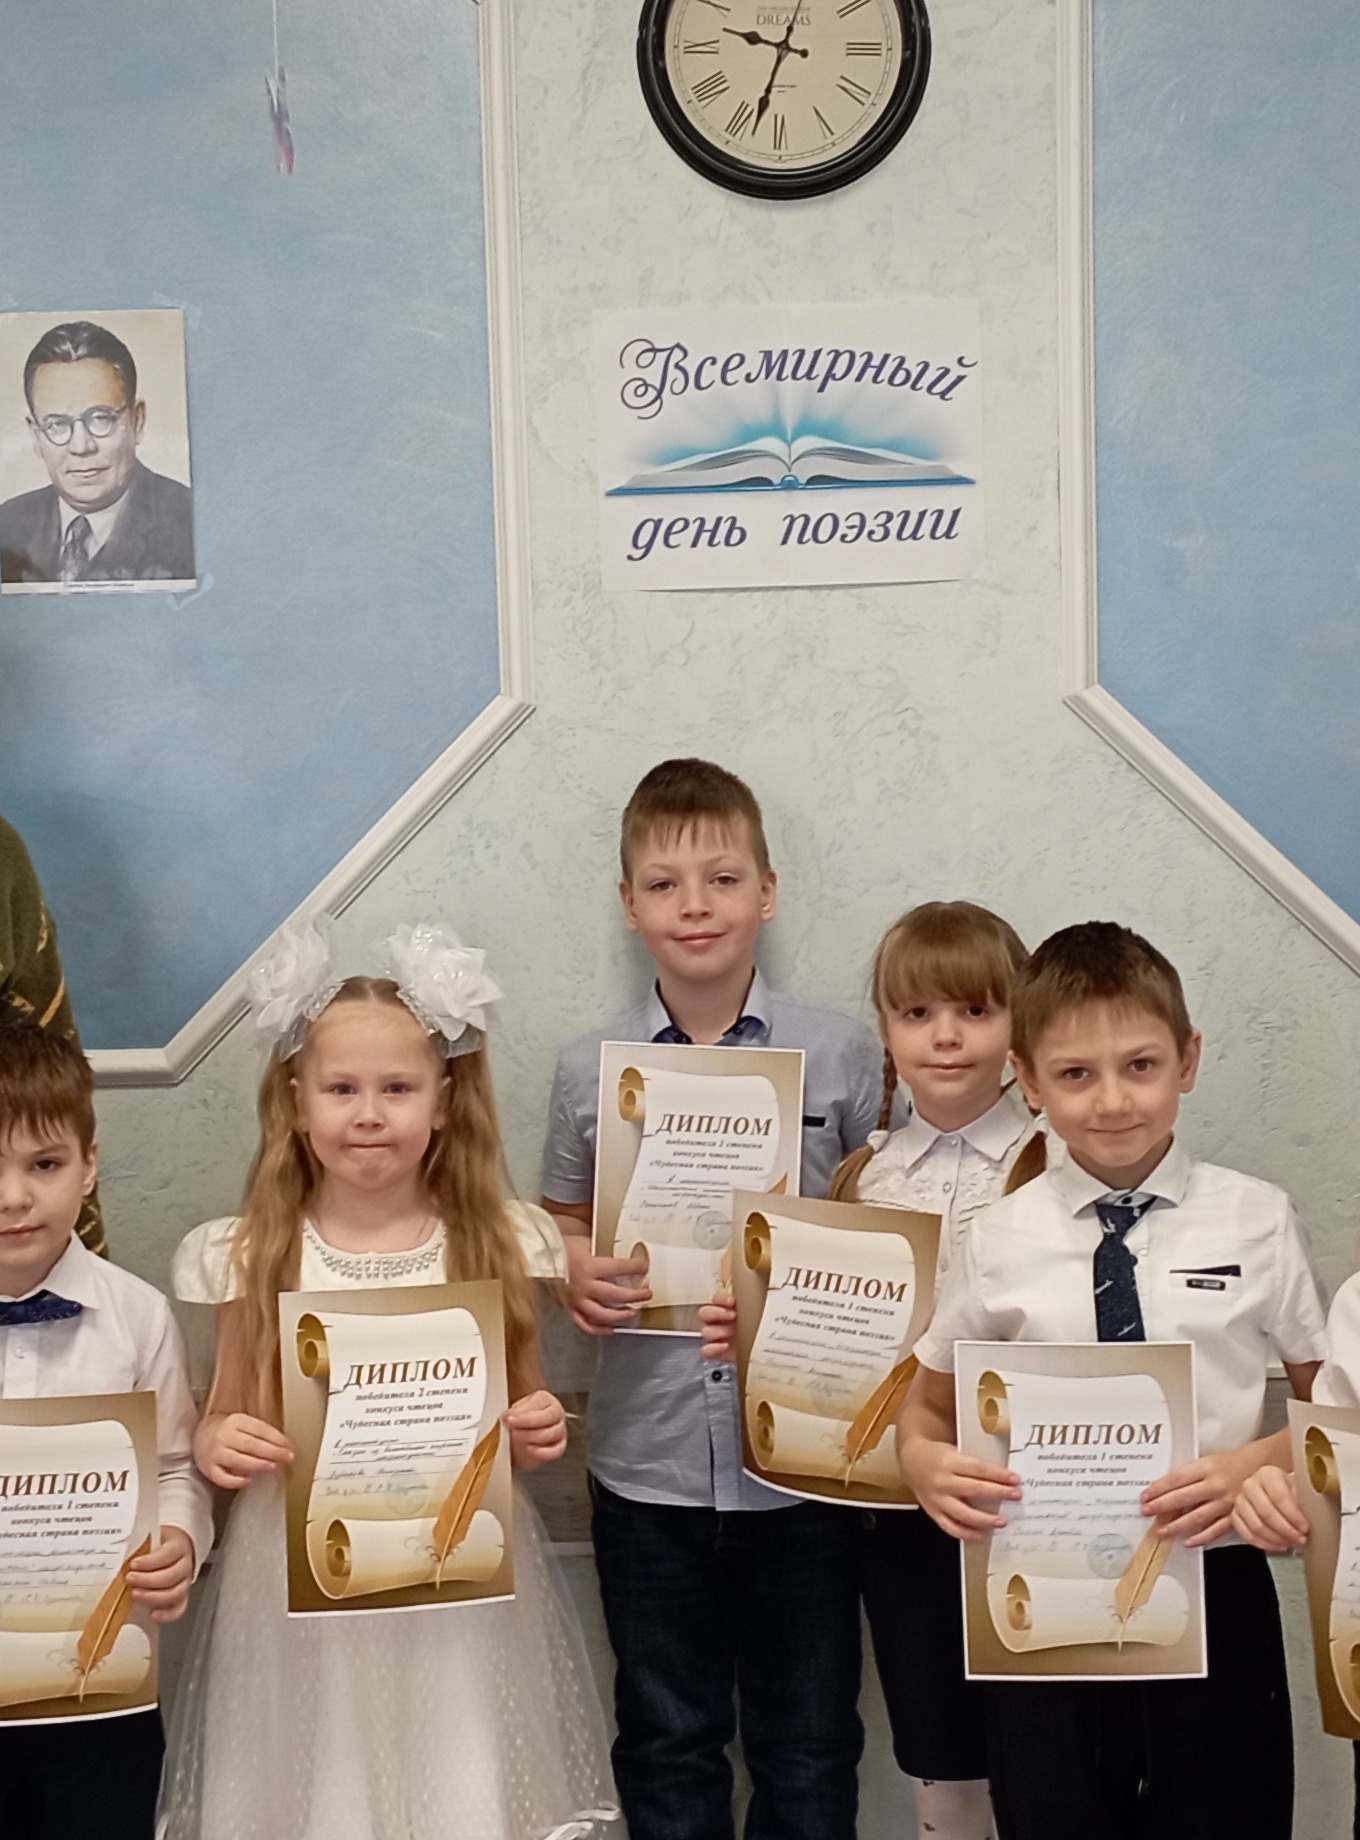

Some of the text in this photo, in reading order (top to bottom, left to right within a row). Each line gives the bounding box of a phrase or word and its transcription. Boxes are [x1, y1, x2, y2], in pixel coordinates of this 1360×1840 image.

[756, 14, 811, 26] DREAMS
[846, 42, 882, 57] III
[691, 70, 730, 109] VIII
[773, 113, 788, 150] VI
[813, 105, 835, 140] V
[620, 338, 978, 419] Всемирный
[626, 506, 962, 561] день поэзии
[655, 1113, 773, 1136] ДИПЛОМ
[780, 1266, 908, 1302] ДИПЛОМ
[342, 1356, 478, 1389] ДИПЛОМ
[1024, 1423, 1163, 1449] ДИПЛОМ
